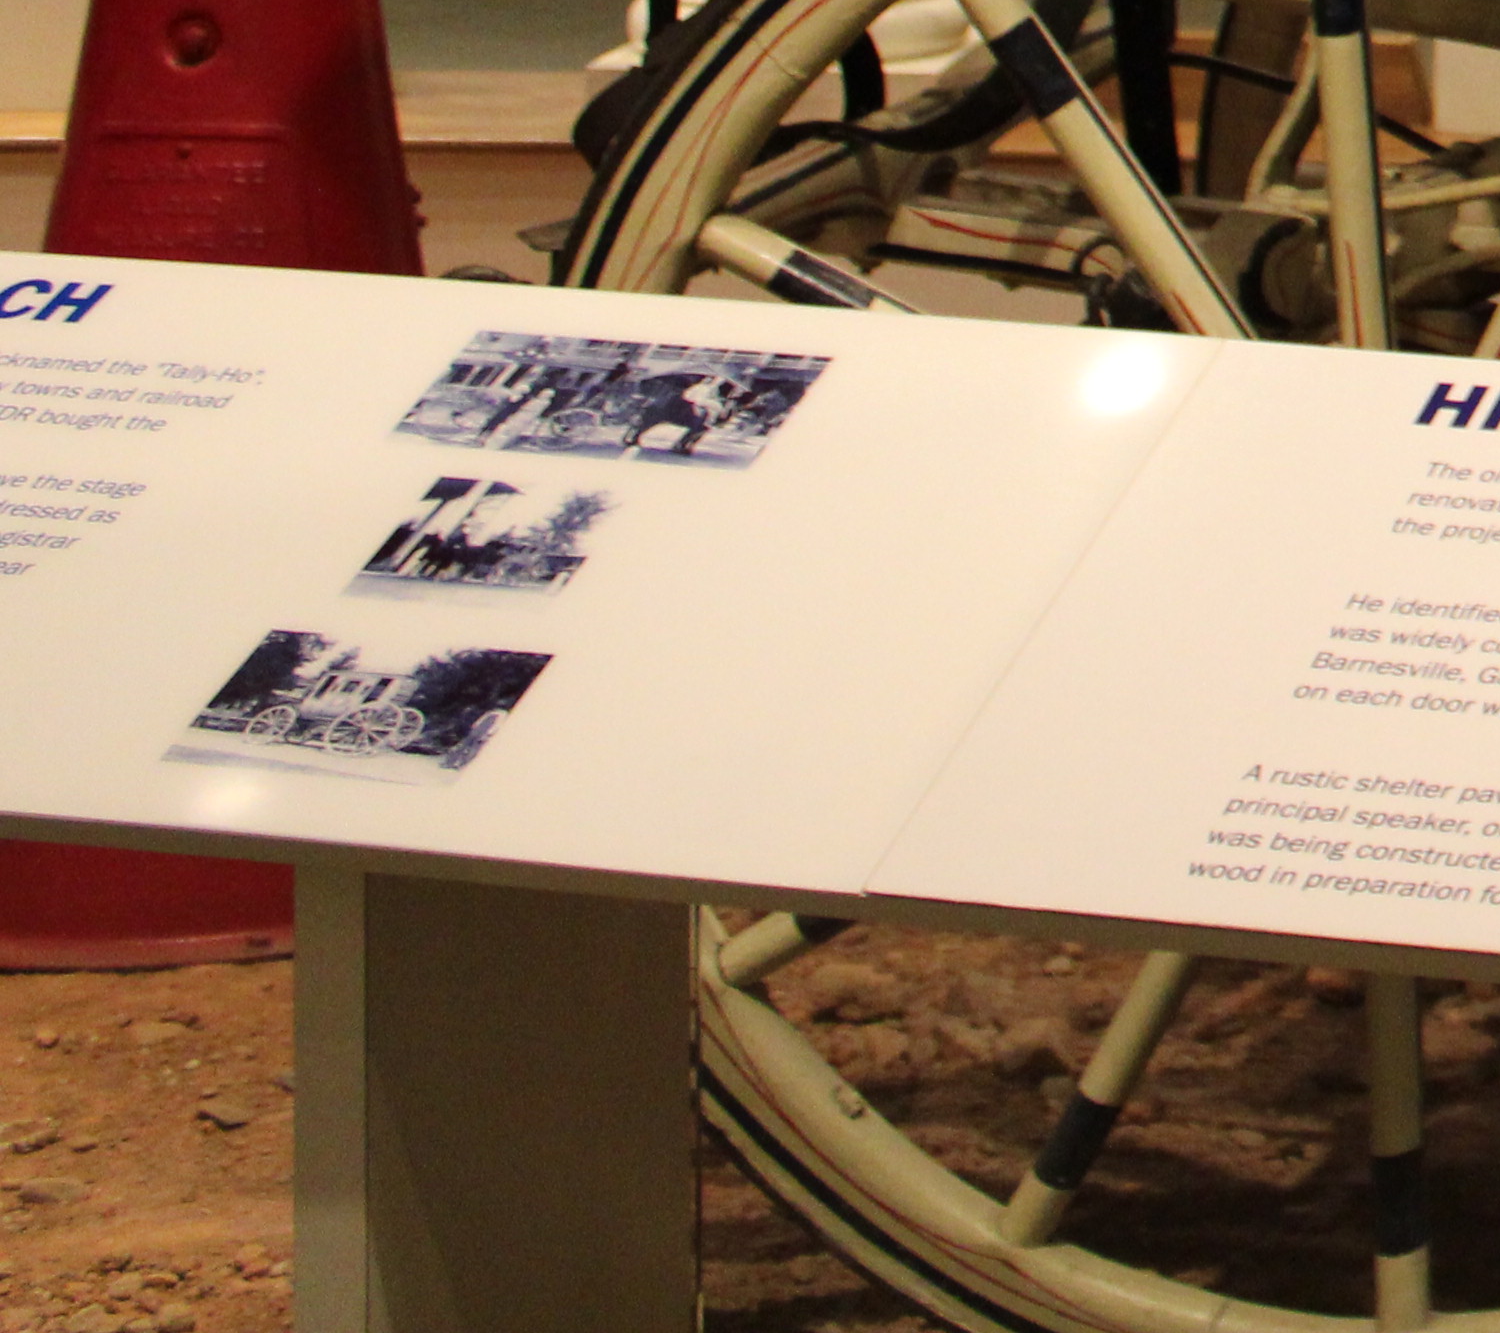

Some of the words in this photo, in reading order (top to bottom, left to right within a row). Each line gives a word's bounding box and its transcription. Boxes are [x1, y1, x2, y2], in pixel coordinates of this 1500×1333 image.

[106, 360, 147, 377] the
[11, 380, 83, 400] towns
[86, 387, 137, 403] and
[140, 390, 234, 410] railroad
[36, 409, 123, 432] bought
[125, 414, 168, 433] the
[1426, 459, 1475, 482] The
[32, 475, 73, 491] the
[76, 480, 147, 500] stage
[87, 509, 121, 524] as
[1391, 516, 1439, 536] the
[1187, 860, 1267, 883] wood
[1268, 864, 1300, 886] in
[1302, 871, 1473, 903] preparation
